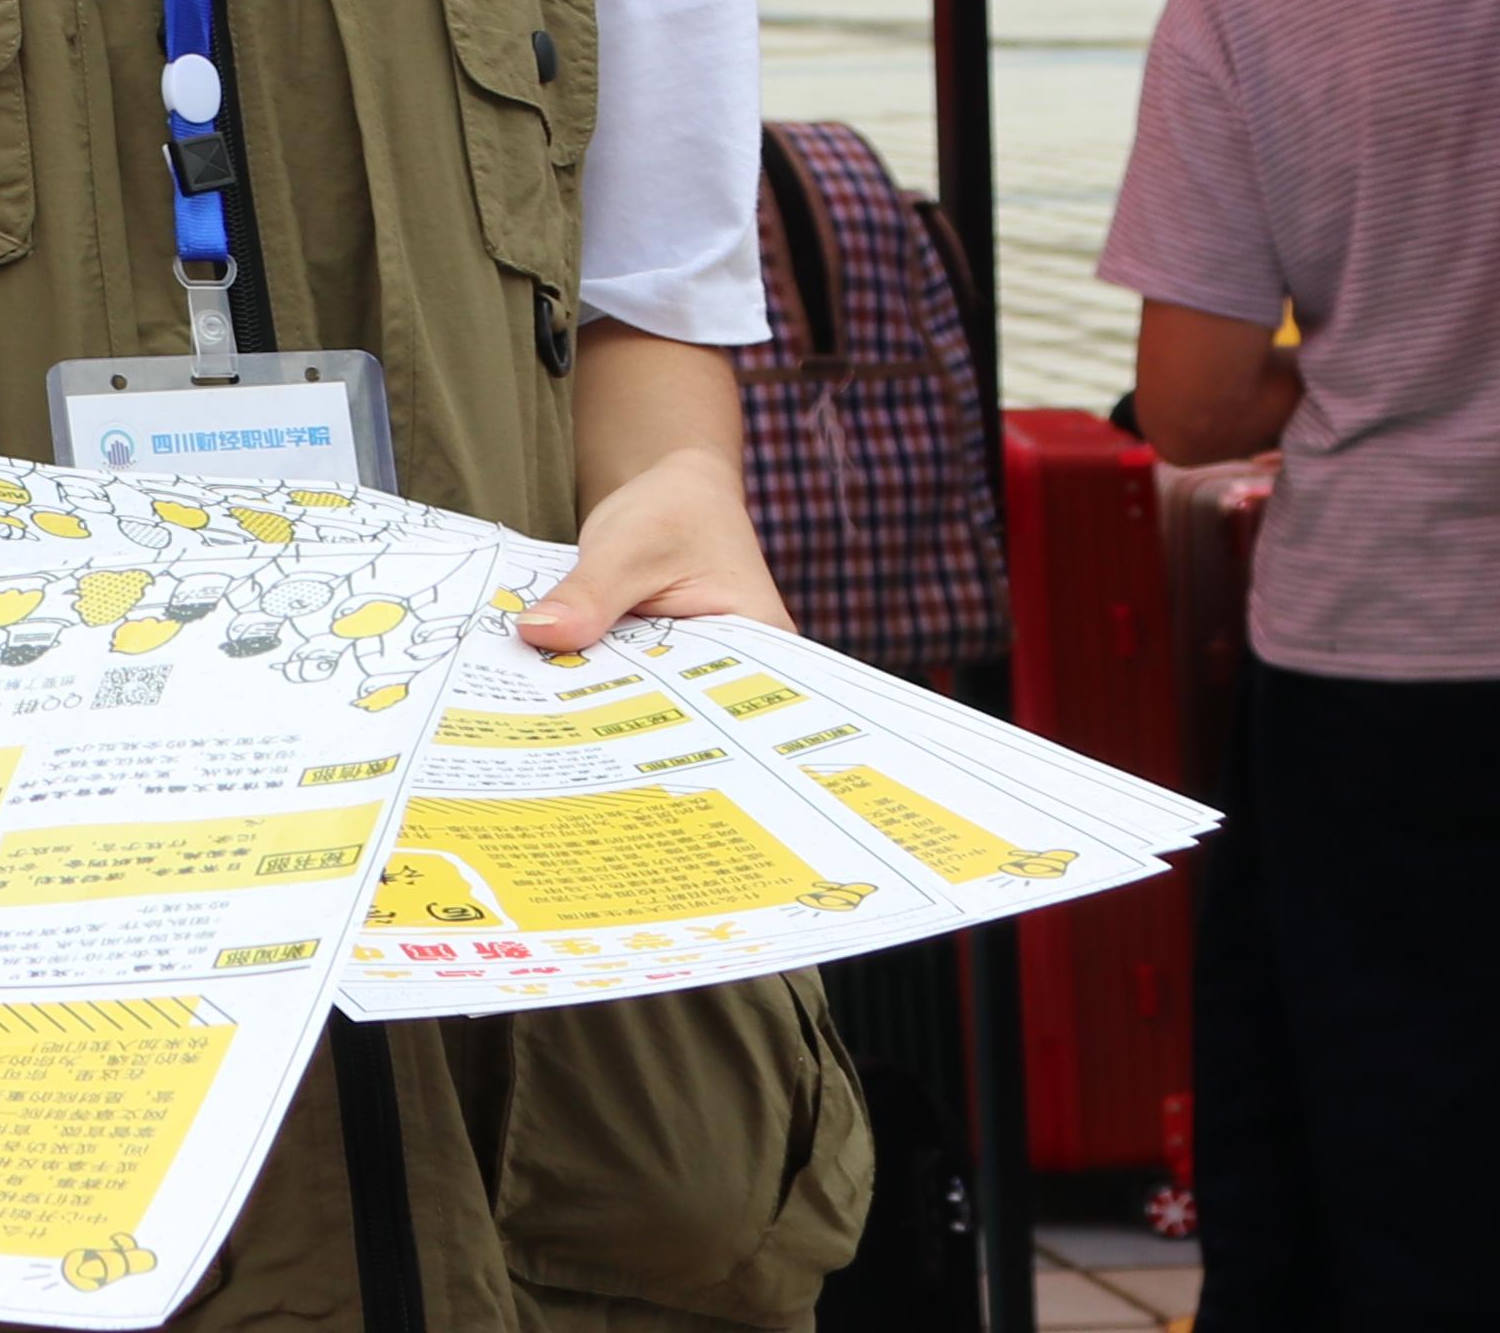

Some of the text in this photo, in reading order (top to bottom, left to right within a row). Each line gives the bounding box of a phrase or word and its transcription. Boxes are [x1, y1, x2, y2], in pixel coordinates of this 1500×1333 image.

[151, 424, 333, 456] 四川财经职业学院
